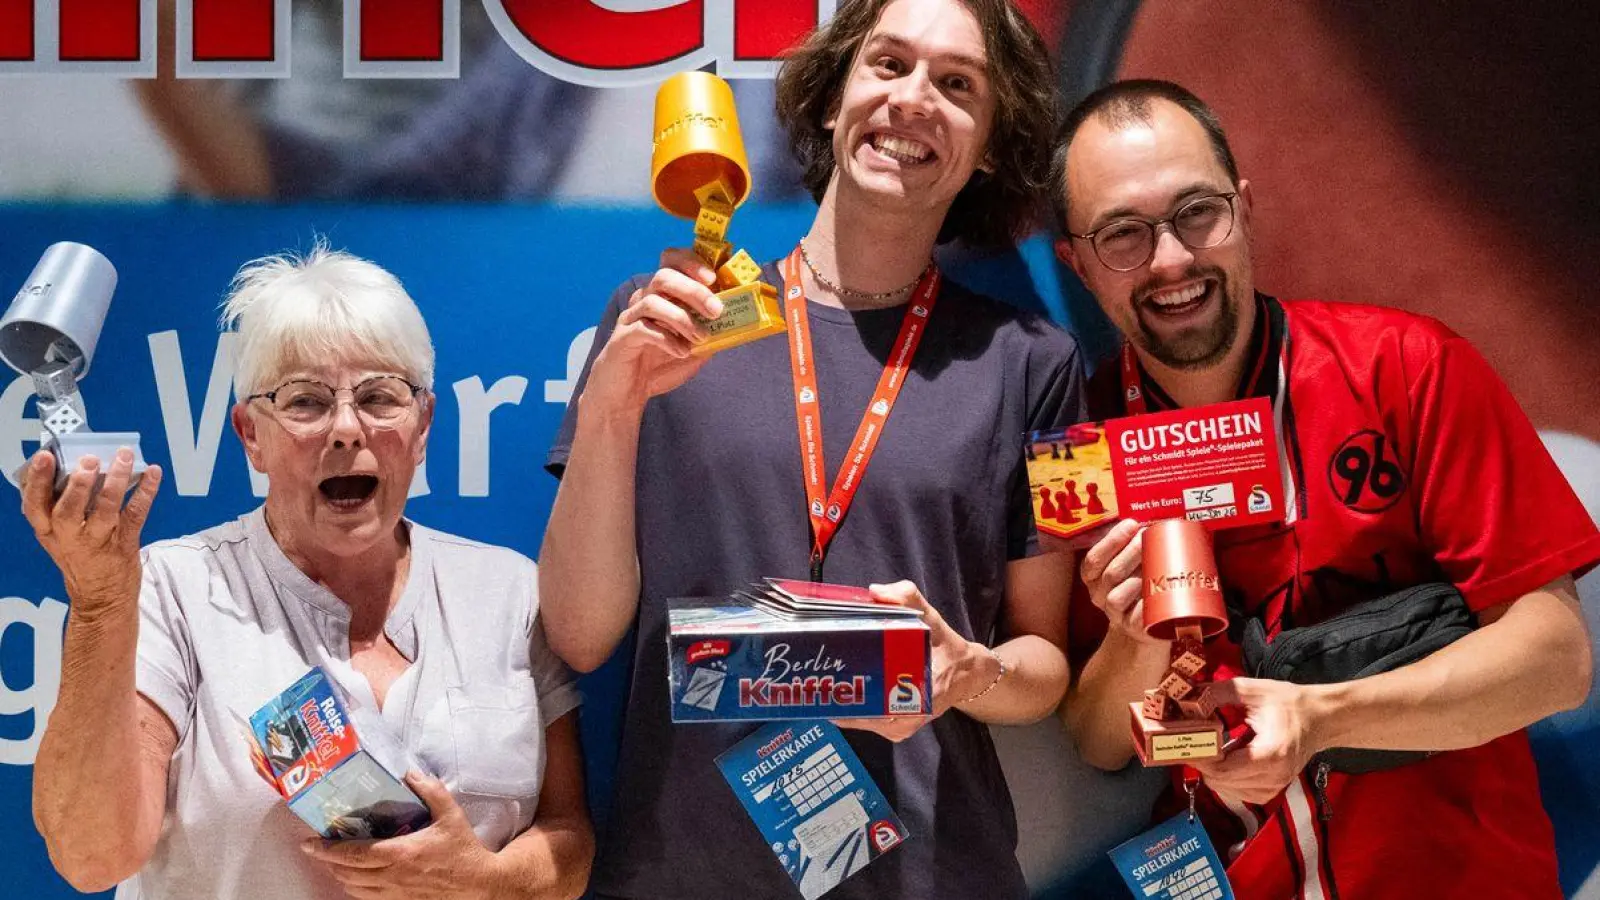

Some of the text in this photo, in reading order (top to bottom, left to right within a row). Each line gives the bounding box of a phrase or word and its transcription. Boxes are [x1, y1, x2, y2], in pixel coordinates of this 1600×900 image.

[1119, 411, 1262, 453] GUTSCHEIN
[1124, 456, 1138, 466] Für
[1138, 454, 1152, 463] ein
[1153, 450, 1185, 461] Schmidt
[1334, 434, 1403, 506] 96
[1131, 497, 1182, 511] Wert in Euro:
[1191, 487, 1218, 505] 75
[1149, 569, 1219, 599] Kniffel
[760, 643, 847, 688] Berlin
[300, 697, 341, 761] Kniffel
[889, 703, 921, 713] Schmidt
[741, 725, 825, 787] SPIELERKARTE
[1132, 836, 1201, 881] SPIELERKARTE
